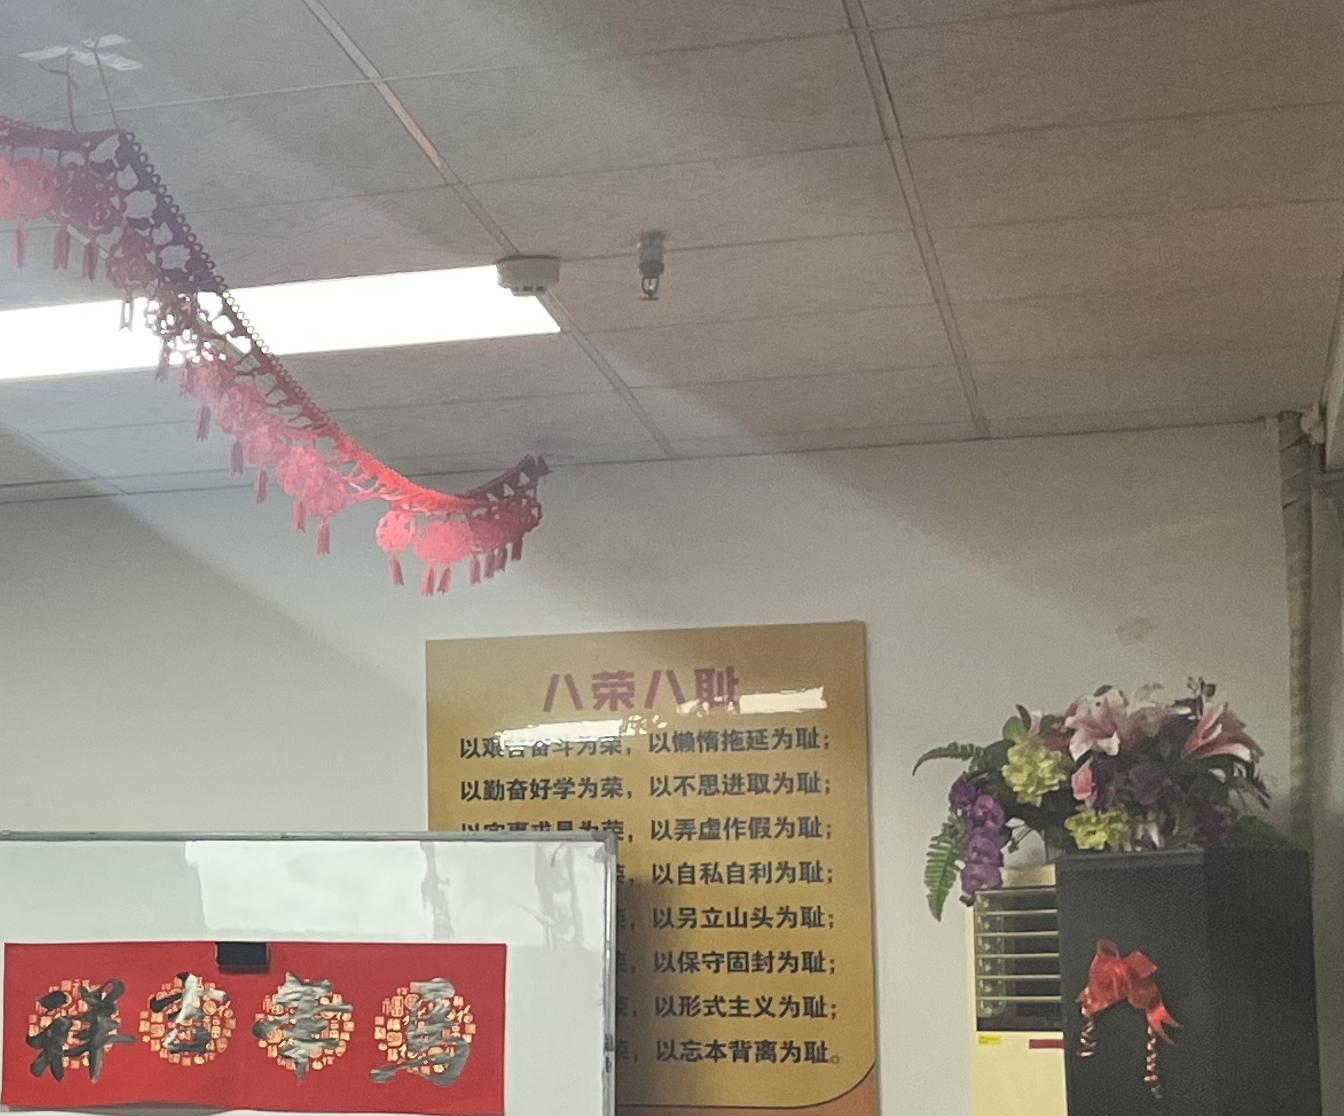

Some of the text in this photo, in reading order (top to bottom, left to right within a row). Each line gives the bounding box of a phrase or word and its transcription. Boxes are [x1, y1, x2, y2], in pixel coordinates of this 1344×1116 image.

[543, 665, 740, 712] 八荣八耻
[460, 771, 832, 802] 以勤奋好学为荣，以不思进取为耻；
